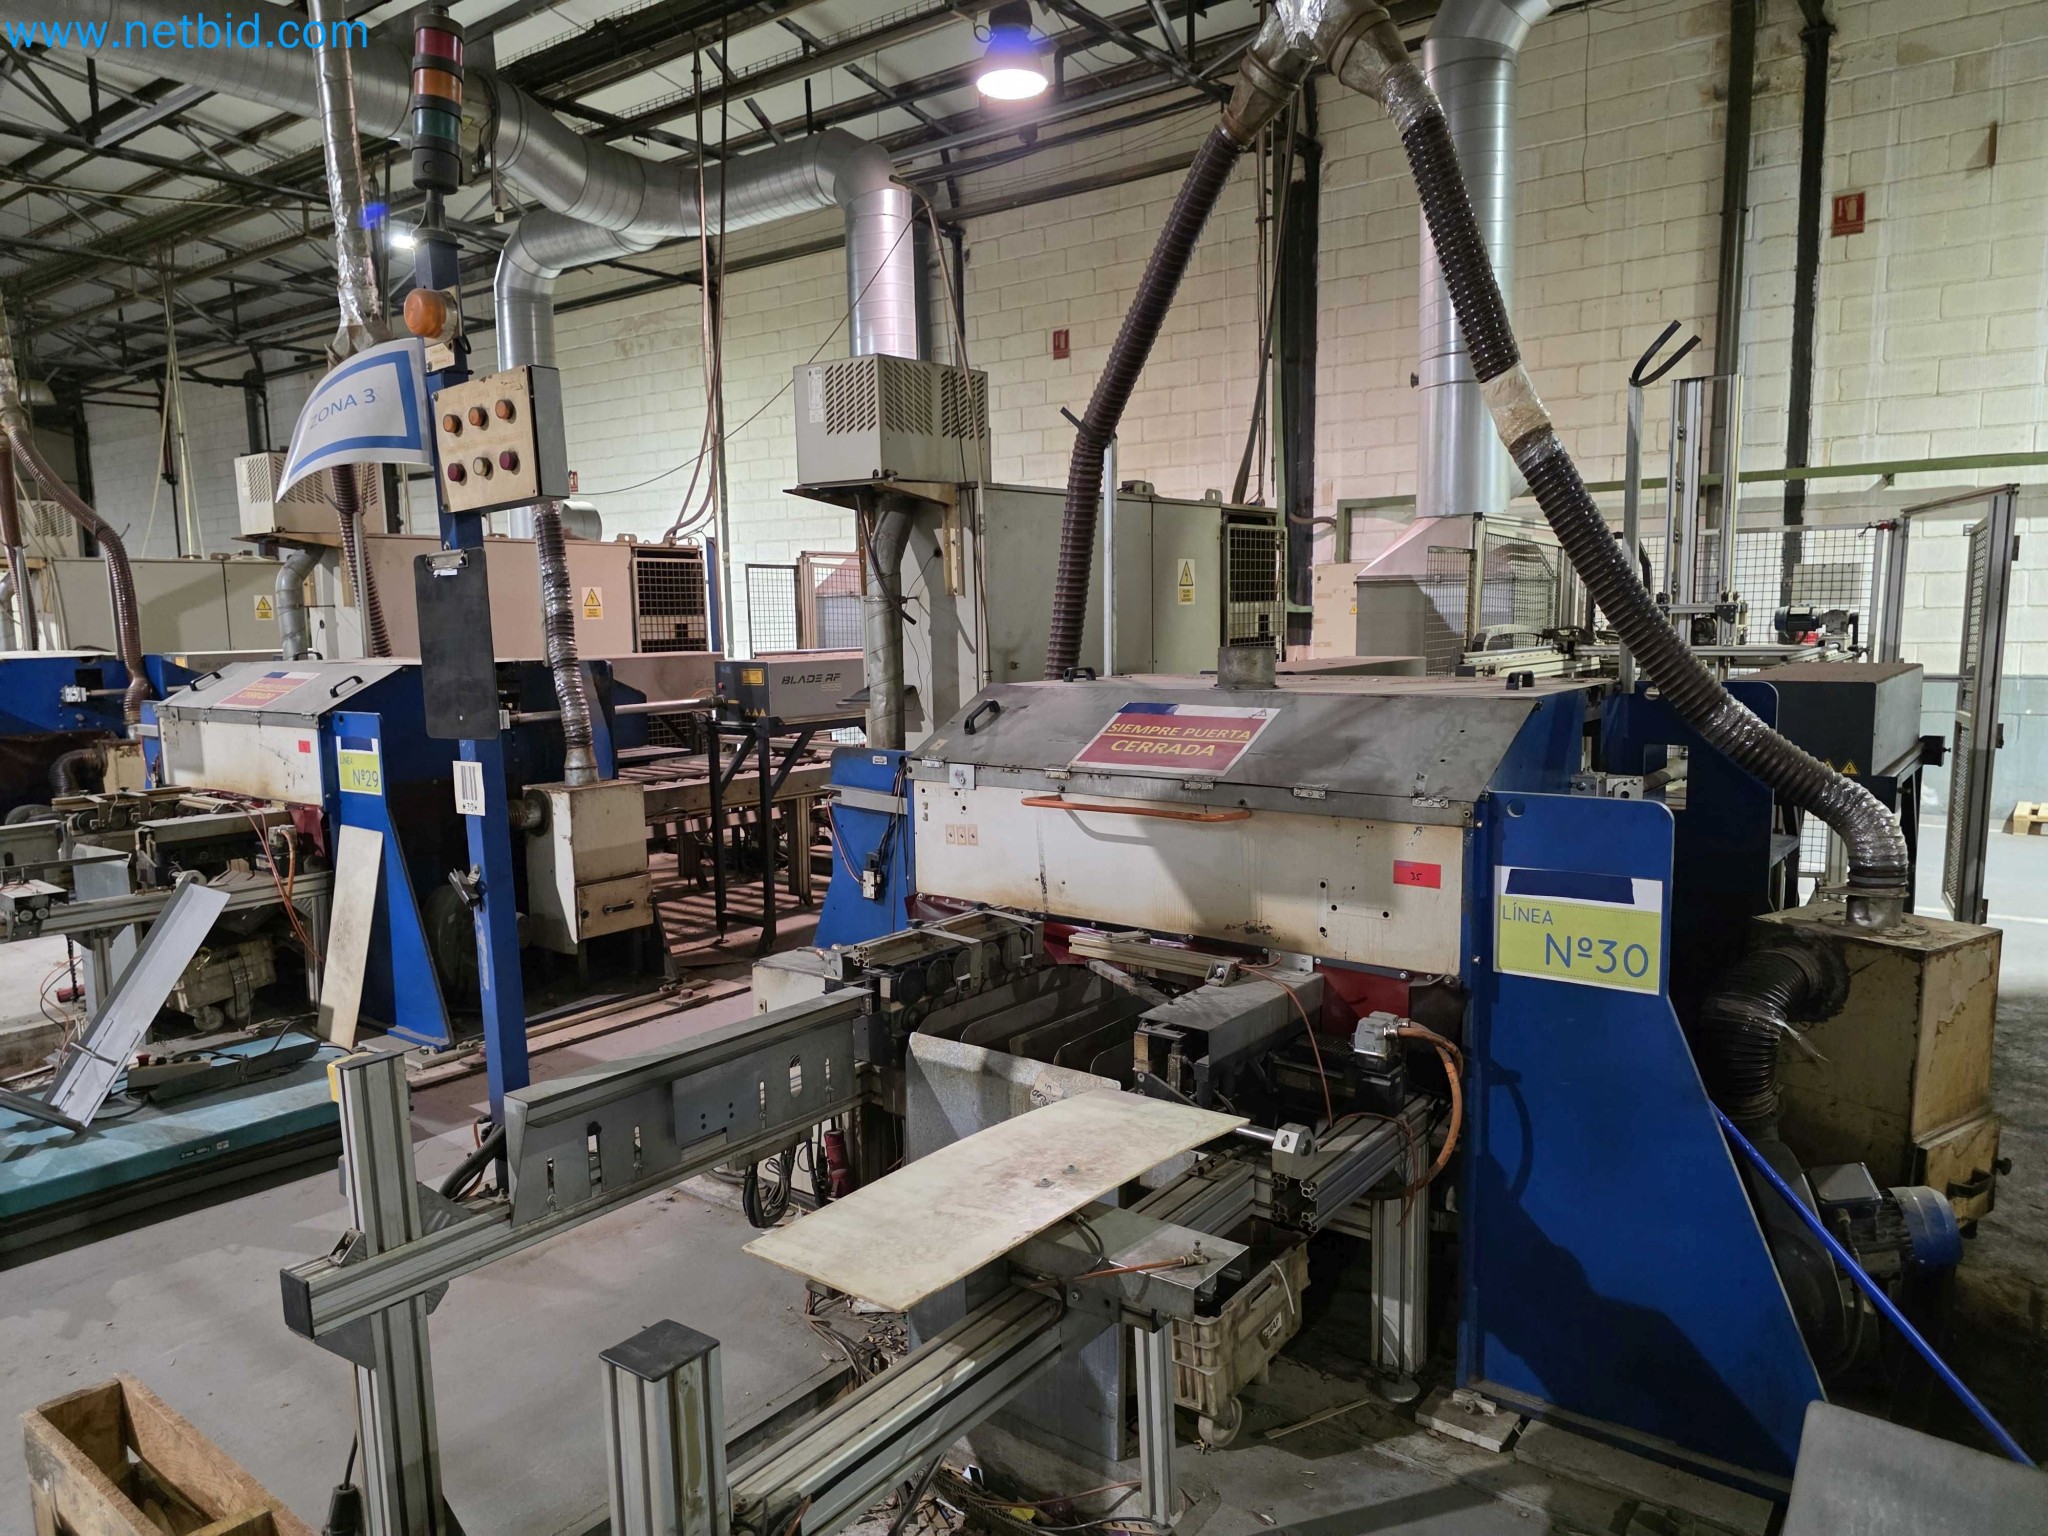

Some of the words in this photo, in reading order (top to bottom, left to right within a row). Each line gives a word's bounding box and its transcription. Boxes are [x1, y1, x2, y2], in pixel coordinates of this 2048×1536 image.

[310, 394, 358, 430] ZONA
[363, 388, 376, 404] 3
[781, 673, 823, 685] BLADE
[825, 672, 842, 683] RF
[1107, 723, 1182, 737] SIEMPRE
[1182, 727, 1252, 740] PUERTA
[1110, 739, 1217, 757] CERRADA
[1502, 902, 1554, 926] LÍNEA
[1545, 932, 1650, 978] Nº30
